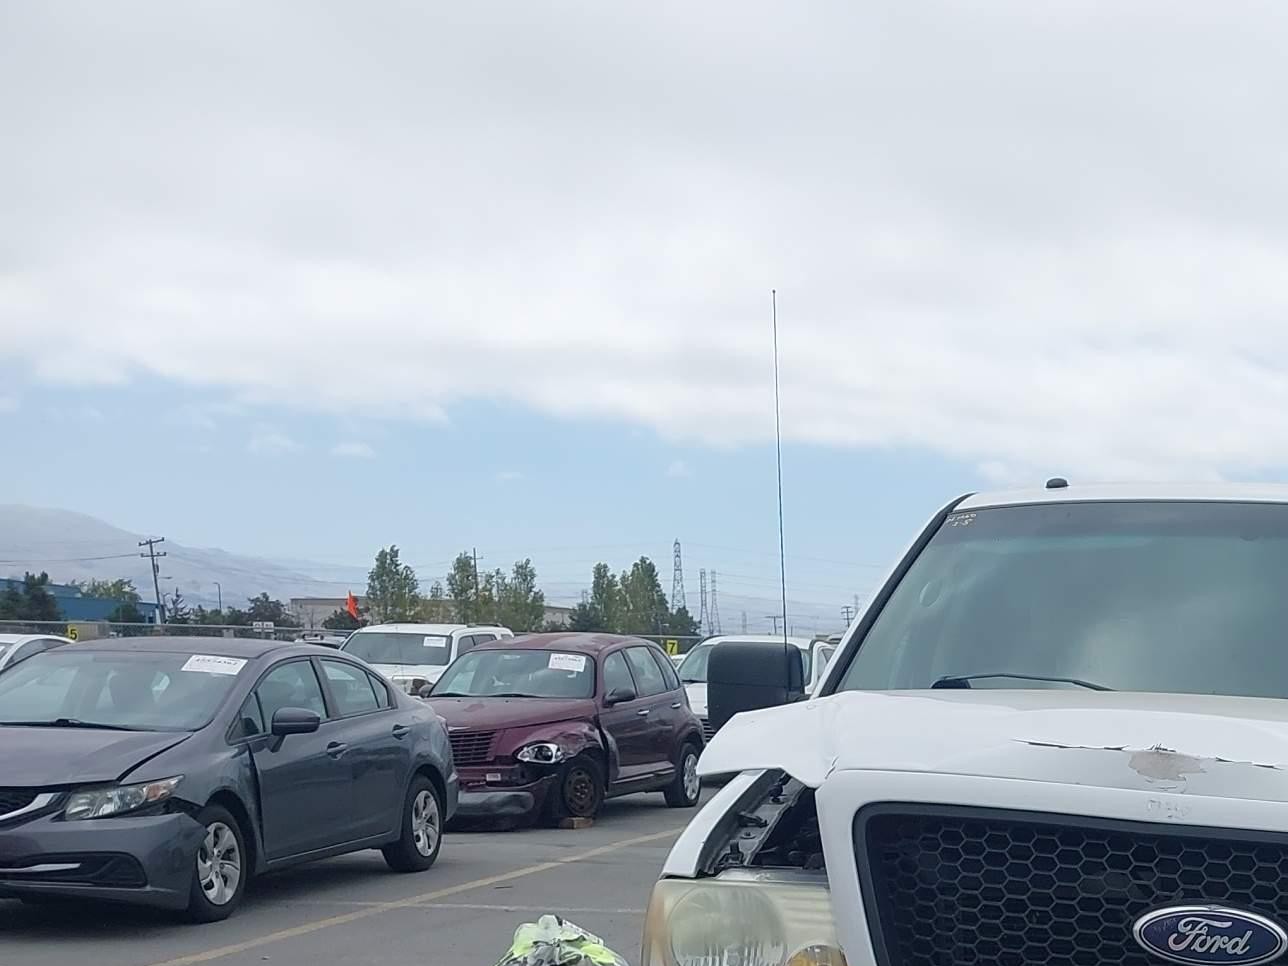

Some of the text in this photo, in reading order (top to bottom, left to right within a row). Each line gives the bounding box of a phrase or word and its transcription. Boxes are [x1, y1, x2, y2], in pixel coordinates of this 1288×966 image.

[70, 629, 77, 640] 5
[668, 642, 676, 654] 7
[1168, 916, 1253, 955] Ford
